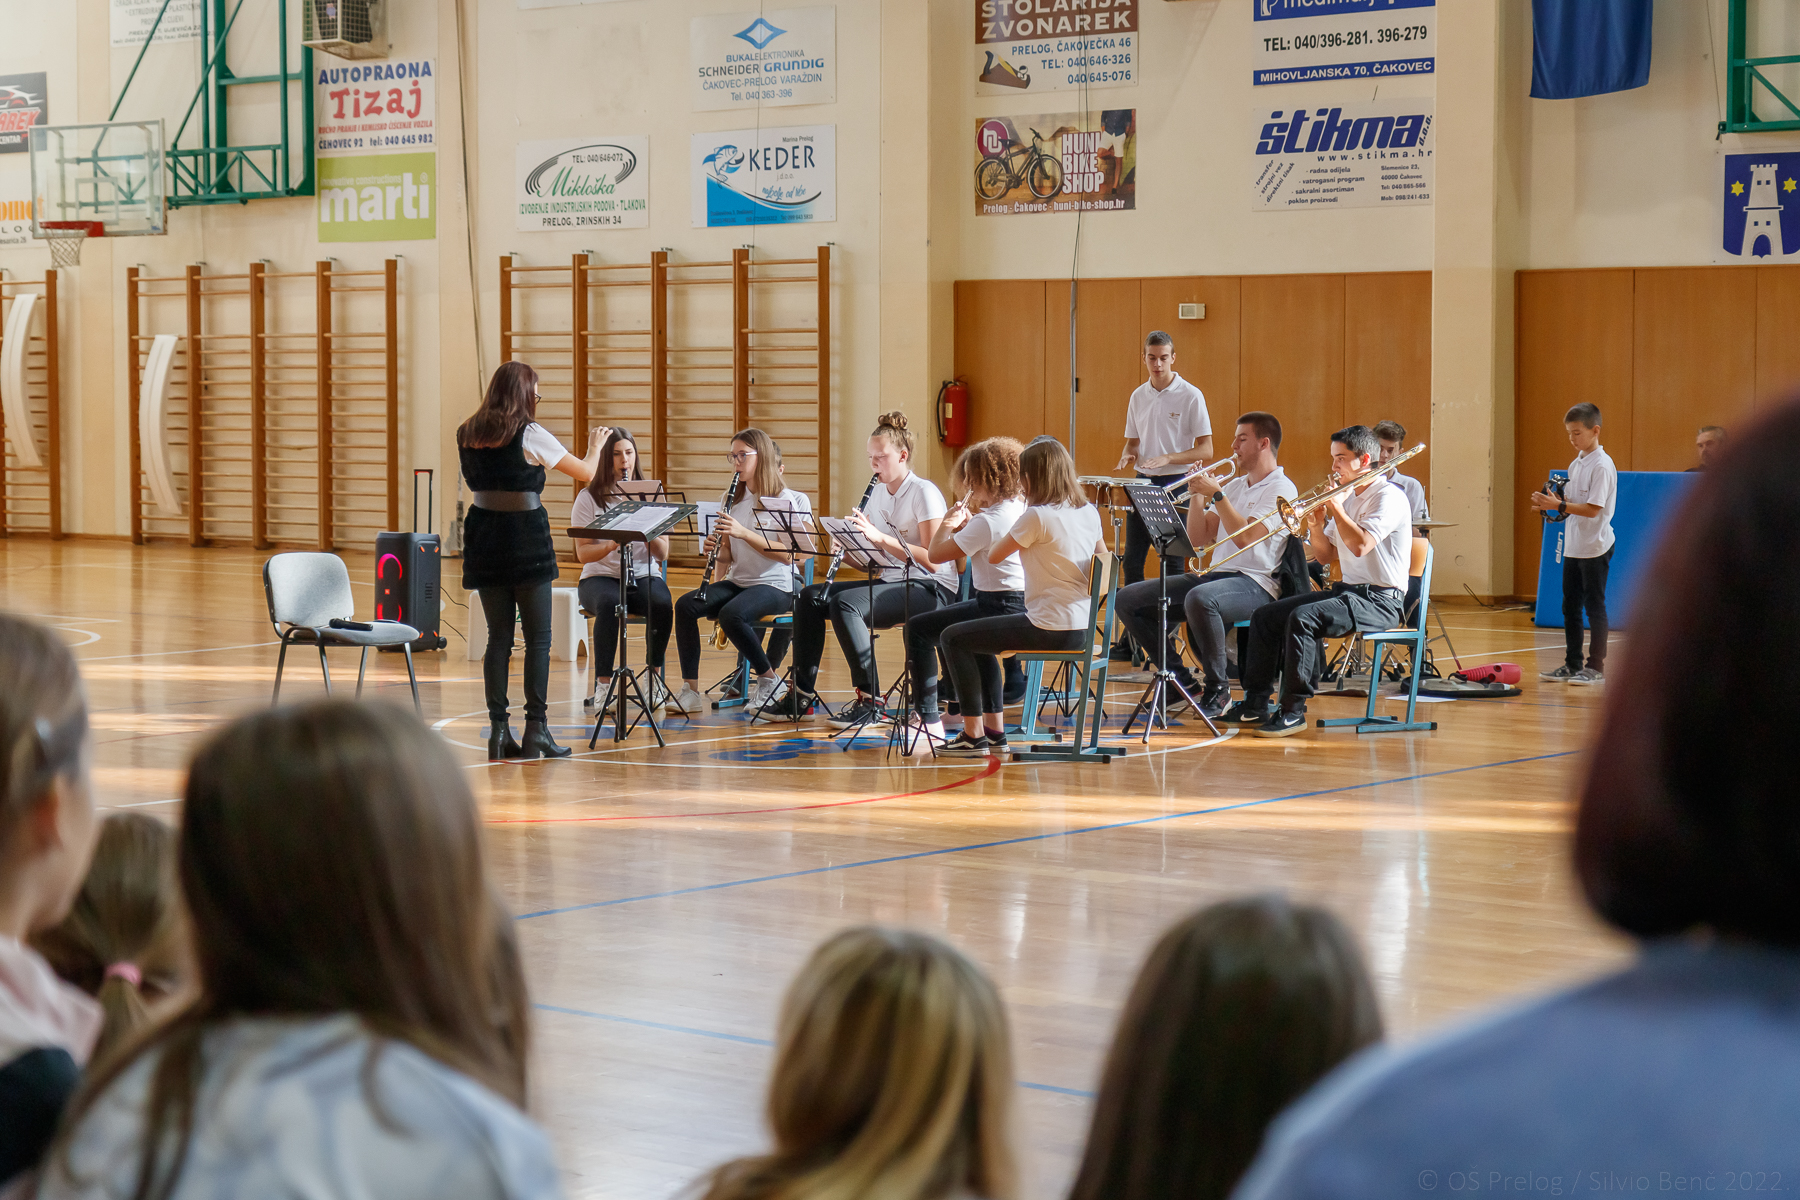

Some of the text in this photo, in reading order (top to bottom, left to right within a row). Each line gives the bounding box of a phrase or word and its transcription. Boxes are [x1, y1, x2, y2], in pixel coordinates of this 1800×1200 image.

[982, 10, 1131, 39] ZVONAREK
[1011, 37, 1131, 56] PRELOG, ČAKOVEČKA 46
[1263, 37, 1291, 52] TEL:
[1377, 25, 1428, 43] 396-279
[726, 49, 805, 63] BUKALELEKTRONIKA
[1041, 53, 1131, 69] TEL: 040/646-326
[318, 61, 432, 85] AUTOPRAONA
[698, 58, 825, 78] SCHNEIDER GRUNDIG
[1067, 70, 1132, 84] 040/645-076
[1260, 61, 1432, 82] MIHOVLJANSKA 70, ČAKOVEC
[702, 71, 822, 91] ČAKOVEC-PRELOG VARAŽDIN
[329, 79, 422, 119] Tizaj
[730, 91, 744, 101] Tel.
[745, 91, 760, 100] 040
[318, 133, 433, 150] ČEHOVEC 92 tel: 040 645 982
[1062, 131, 1102, 154] HUNI
[572, 154, 586, 163] TEL:
[749, 145, 815, 172] KEDER
[1062, 152, 1099, 174] BIKE
[1330, 166, 1351, 175] odijela
[536, 166, 616, 198] Mikloška
[1062, 171, 1105, 194] SHOP
[1302, 176, 1365, 185] vatrogasni program
[320, 172, 429, 223] marti
[1295, 186, 1320, 195] sakralni
[593, 200, 615, 211] PODOVA
[620, 199, 646, 211] TLAKOVA
[983, 203, 1008, 214] Prelog
[1014, 201, 1048, 212] Čakovec
[542, 215, 622, 227] PRELOG, ZRINSKIH 34
